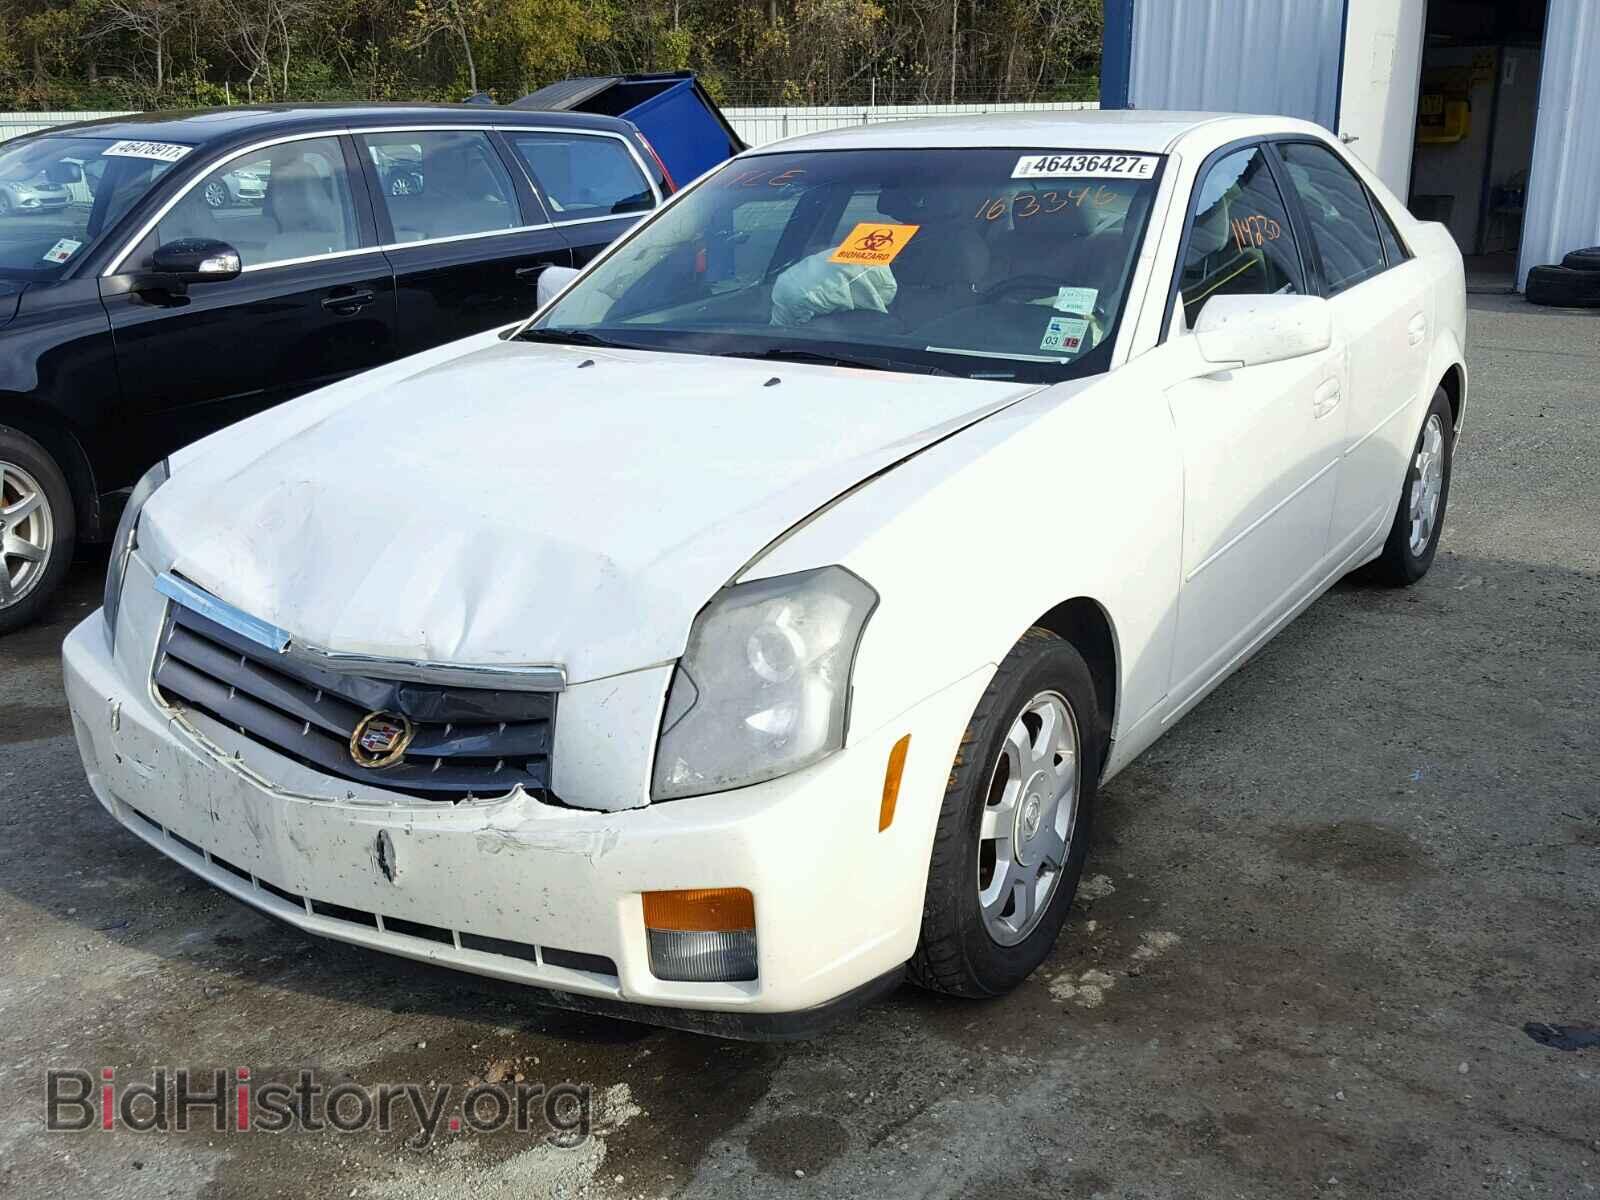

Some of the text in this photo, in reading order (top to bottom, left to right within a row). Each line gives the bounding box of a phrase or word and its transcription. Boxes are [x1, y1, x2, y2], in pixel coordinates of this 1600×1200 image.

[1033, 155, 1142, 173] 46436427
[838, 250, 890, 261] BIOHAZARD
[1045, 335, 1059, 345] 03
